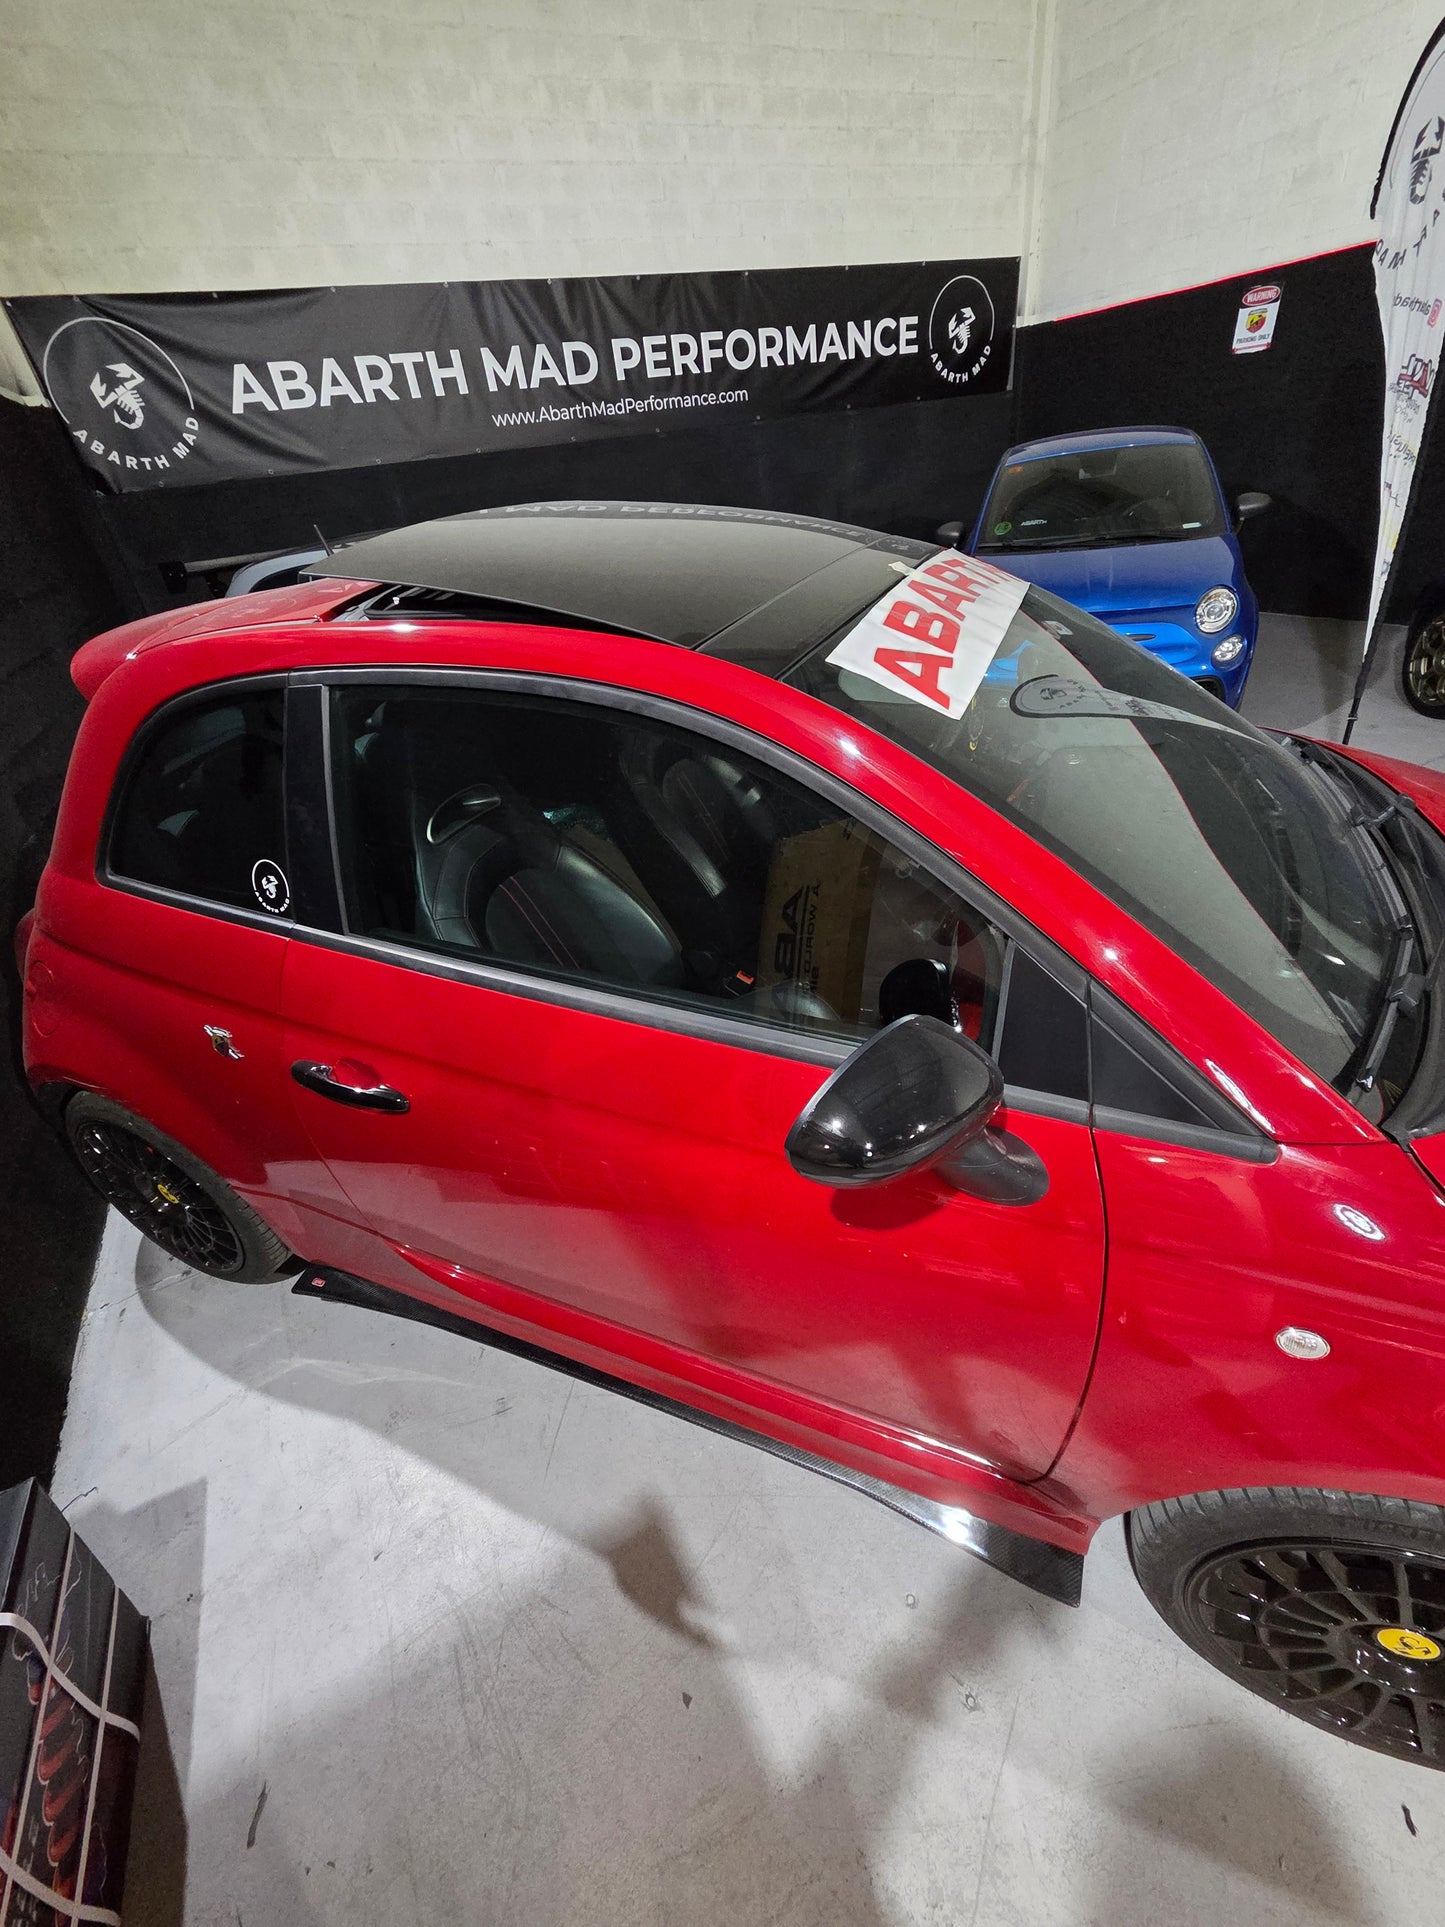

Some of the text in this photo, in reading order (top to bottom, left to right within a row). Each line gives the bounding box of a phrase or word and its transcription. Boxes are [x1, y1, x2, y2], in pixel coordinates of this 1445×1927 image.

[1247, 288, 1278, 303] WARNING
[231, 315, 920, 414] ABARTH MAD PERFORMANCE
[930, 345, 991, 383] ABARTH MAD
[491, 387, 749, 428] www.AbarthMadPerformance.com
[73, 417, 199, 470] ABARTH MAD
